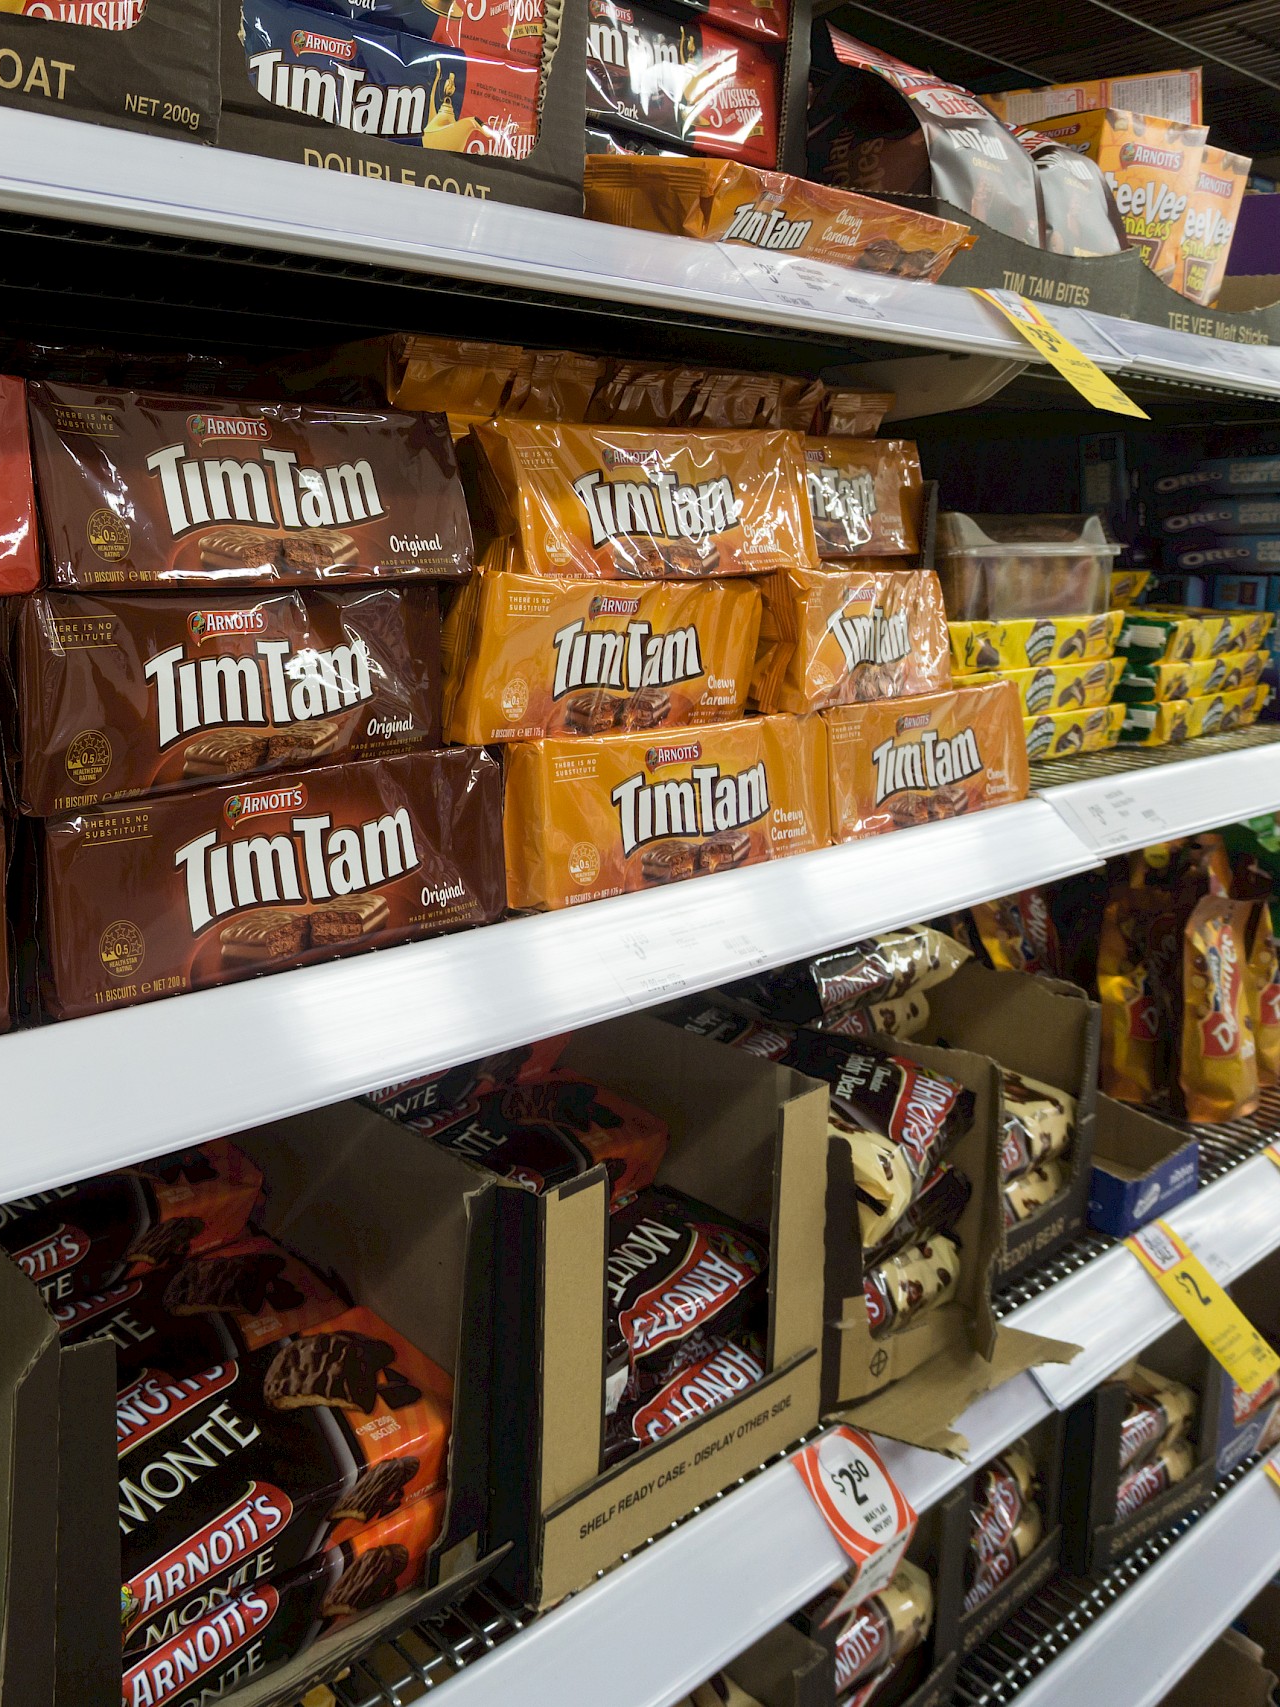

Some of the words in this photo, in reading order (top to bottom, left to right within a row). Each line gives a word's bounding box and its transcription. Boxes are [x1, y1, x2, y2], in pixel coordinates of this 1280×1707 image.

[306, 35, 351, 57] ARNOTT'S
[719, 88, 760, 109] WISHES
[125, 93, 160, 117] NET
[163, 103, 200, 130] 200g
[617, 101, 638, 119] Dark
[1134, 149, 1181, 169] ARNOTT'S
[1198, 176, 1232, 196] ARNOTT'S
[836, 209, 862, 234] Chewy
[822, 226, 860, 247] Caramel
[1003, 271, 1024, 293] TIM
[1028, 276, 1054, 300] TAM
[1056, 282, 1089, 307] BITES
[1168, 312, 1189, 332] TEE
[1192, 317, 1213, 336] VEE
[1215, 321, 1237, 341] Malt
[1239, 326, 1268, 345] Sticks
[58, 419, 114, 430] SUBSTITUTE
[207, 419, 267, 438] ARNOTT'S
[390, 533, 442, 557] Original
[600, 597, 639, 613] ARNOTT'S
[206, 612, 263, 631] ARNOTT'S
[707, 675, 735, 693] Chewy
[700, 690, 736, 706] Caramel
[367, 712, 414, 739] Original
[82, 752, 94, 764] 0.5
[657, 743, 699, 761] ARNOTT'S
[55, 798, 62, 809] 11
[66, 794, 97, 808] BISCUITS
[241, 792, 302, 814] ARNOTT'S
[85, 819, 117, 828] THERE
[773, 808, 804, 824] Chewy
[86, 825, 148, 838] SUBSTITUTE
[771, 824, 807, 841] Caramel
[421, 877, 465, 907] Original
[116, 944, 128, 955] 0.5
[95, 992, 103, 1004] 11
[106, 985, 137, 1001] BISCUITS
[154, 979, 165, 991] NET
[168, 976, 180, 988] 200
[119, 1400, 261, 1535] MONTE
[579, 1509, 617, 1540] SHELF
[618, 1480, 655, 1514] READY
[657, 1461, 686, 1489] CASE
[694, 1438, 735, 1465] DISPLAY
[737, 1412, 769, 1438] OTHER
[770, 1394, 792, 1417] SIDE
[142, 1495, 282, 1614] ARNOTT'S
[132, 1587, 268, 1707] ARNOTT'S
